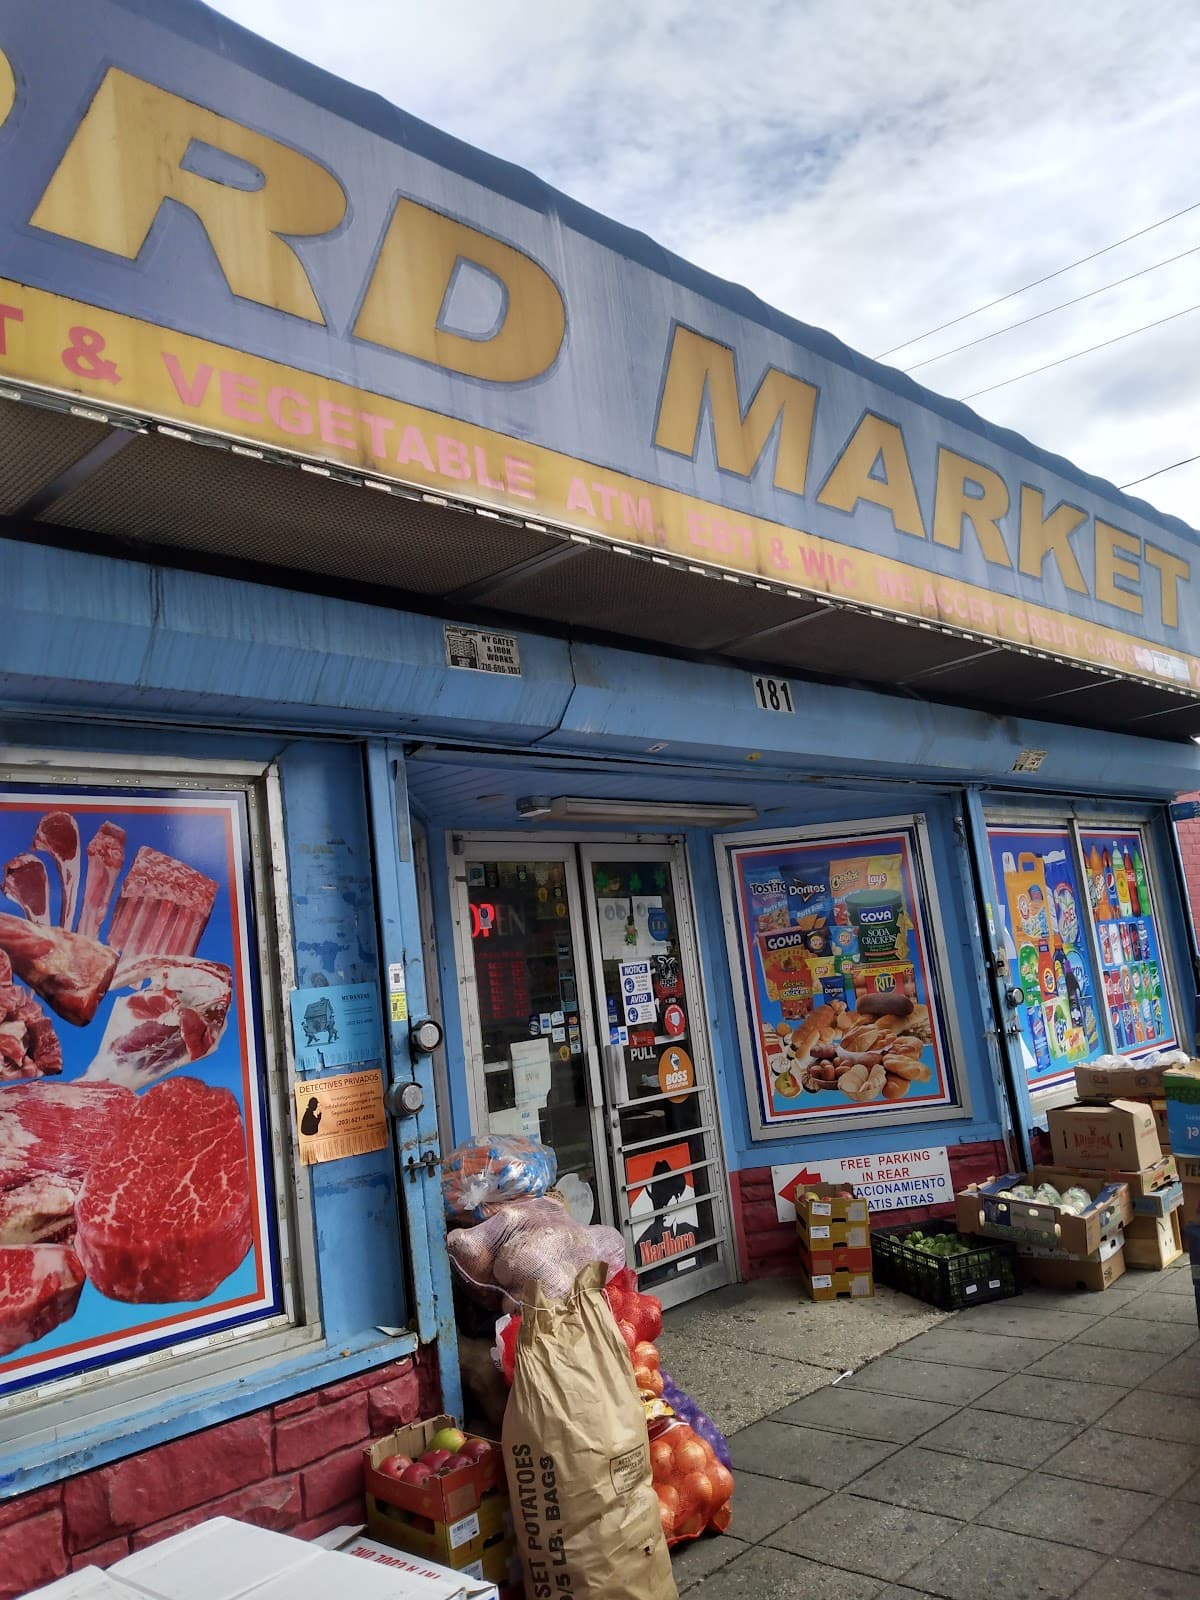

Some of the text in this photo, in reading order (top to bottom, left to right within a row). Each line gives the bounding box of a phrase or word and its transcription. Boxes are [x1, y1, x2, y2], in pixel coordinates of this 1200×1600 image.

[0, 48, 1190, 629] RD MARKET
[61, 326, 122, 385] &
[160, 350, 537, 500] VEGETABLE
[687, 510, 753, 560] EBT
[769, 537, 791, 570] &
[799, 546, 857, 590] WIC
[874, 568, 913, 603] WE
[923, 583, 1006, 630] ACCEPT
[1014, 610, 1079, 647] CREDIT
[1083, 631, 1137, 665] CARDS
[481, 635, 514, 647] NY GATES
[486, 653, 514, 664] WORKS
[756, 678, 792, 712] 181
[789, 882, 826, 896] Doritos
[860, 909, 893, 924] GOYA
[861, 933, 897, 946] CRACKERS
[867, 927, 891, 938] SODA
[767, 933, 802, 951] GOYA
[624, 964, 646, 975] NOTICE
[876, 975, 895, 992] RITZ
[630, 994, 648, 1004] AVISO
[631, 1046, 656, 1061] PULL
[299, 1072, 379, 1094] DETECTIVES PRIVADOS
[665, 1070, 688, 1085] BOSS
[840, 1150, 931, 1171] FREE PARKING
[862, 1167, 910, 1182] IN REAR
[896, 1192, 935, 1206] ATRAS
[639, 1230, 696, 1266] Marlboro
[540, 1455, 561, 1521] BAGS
[512, 1443, 551, 1598] SET POTATOES
[548, 1528, 567, 1566] LB.
